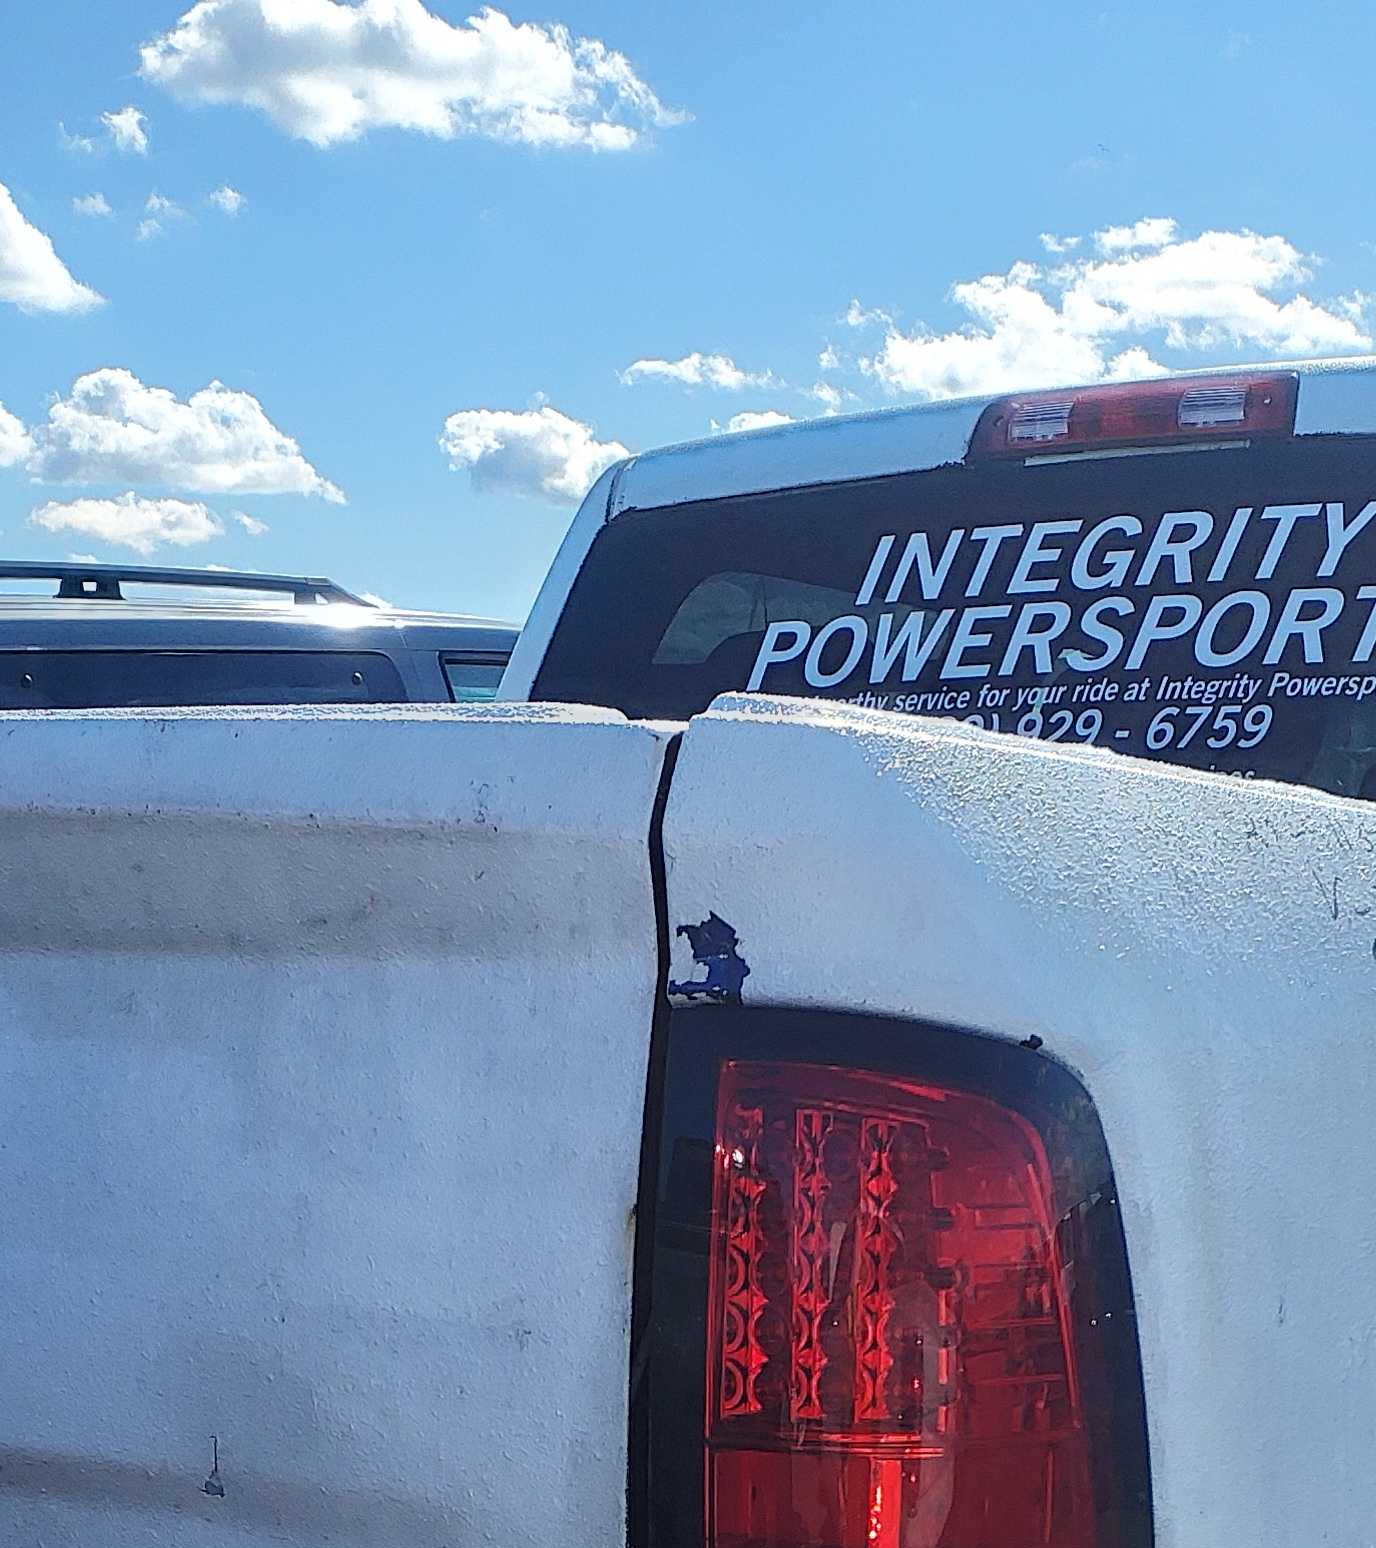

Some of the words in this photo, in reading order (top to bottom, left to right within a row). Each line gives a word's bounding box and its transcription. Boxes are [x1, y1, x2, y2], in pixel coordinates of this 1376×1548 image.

[894, 686, 971, 712] service
[975, 683, 1012, 707] for
[1011, 687, 1067, 712] your
[1071, 676, 1118, 702] ride
[1123, 677, 1148, 701] at
[1155, 675, 1263, 704] Integrity
[1015, 708, 1103, 743] 929
[1145, 704, 1274, 750] 6759
